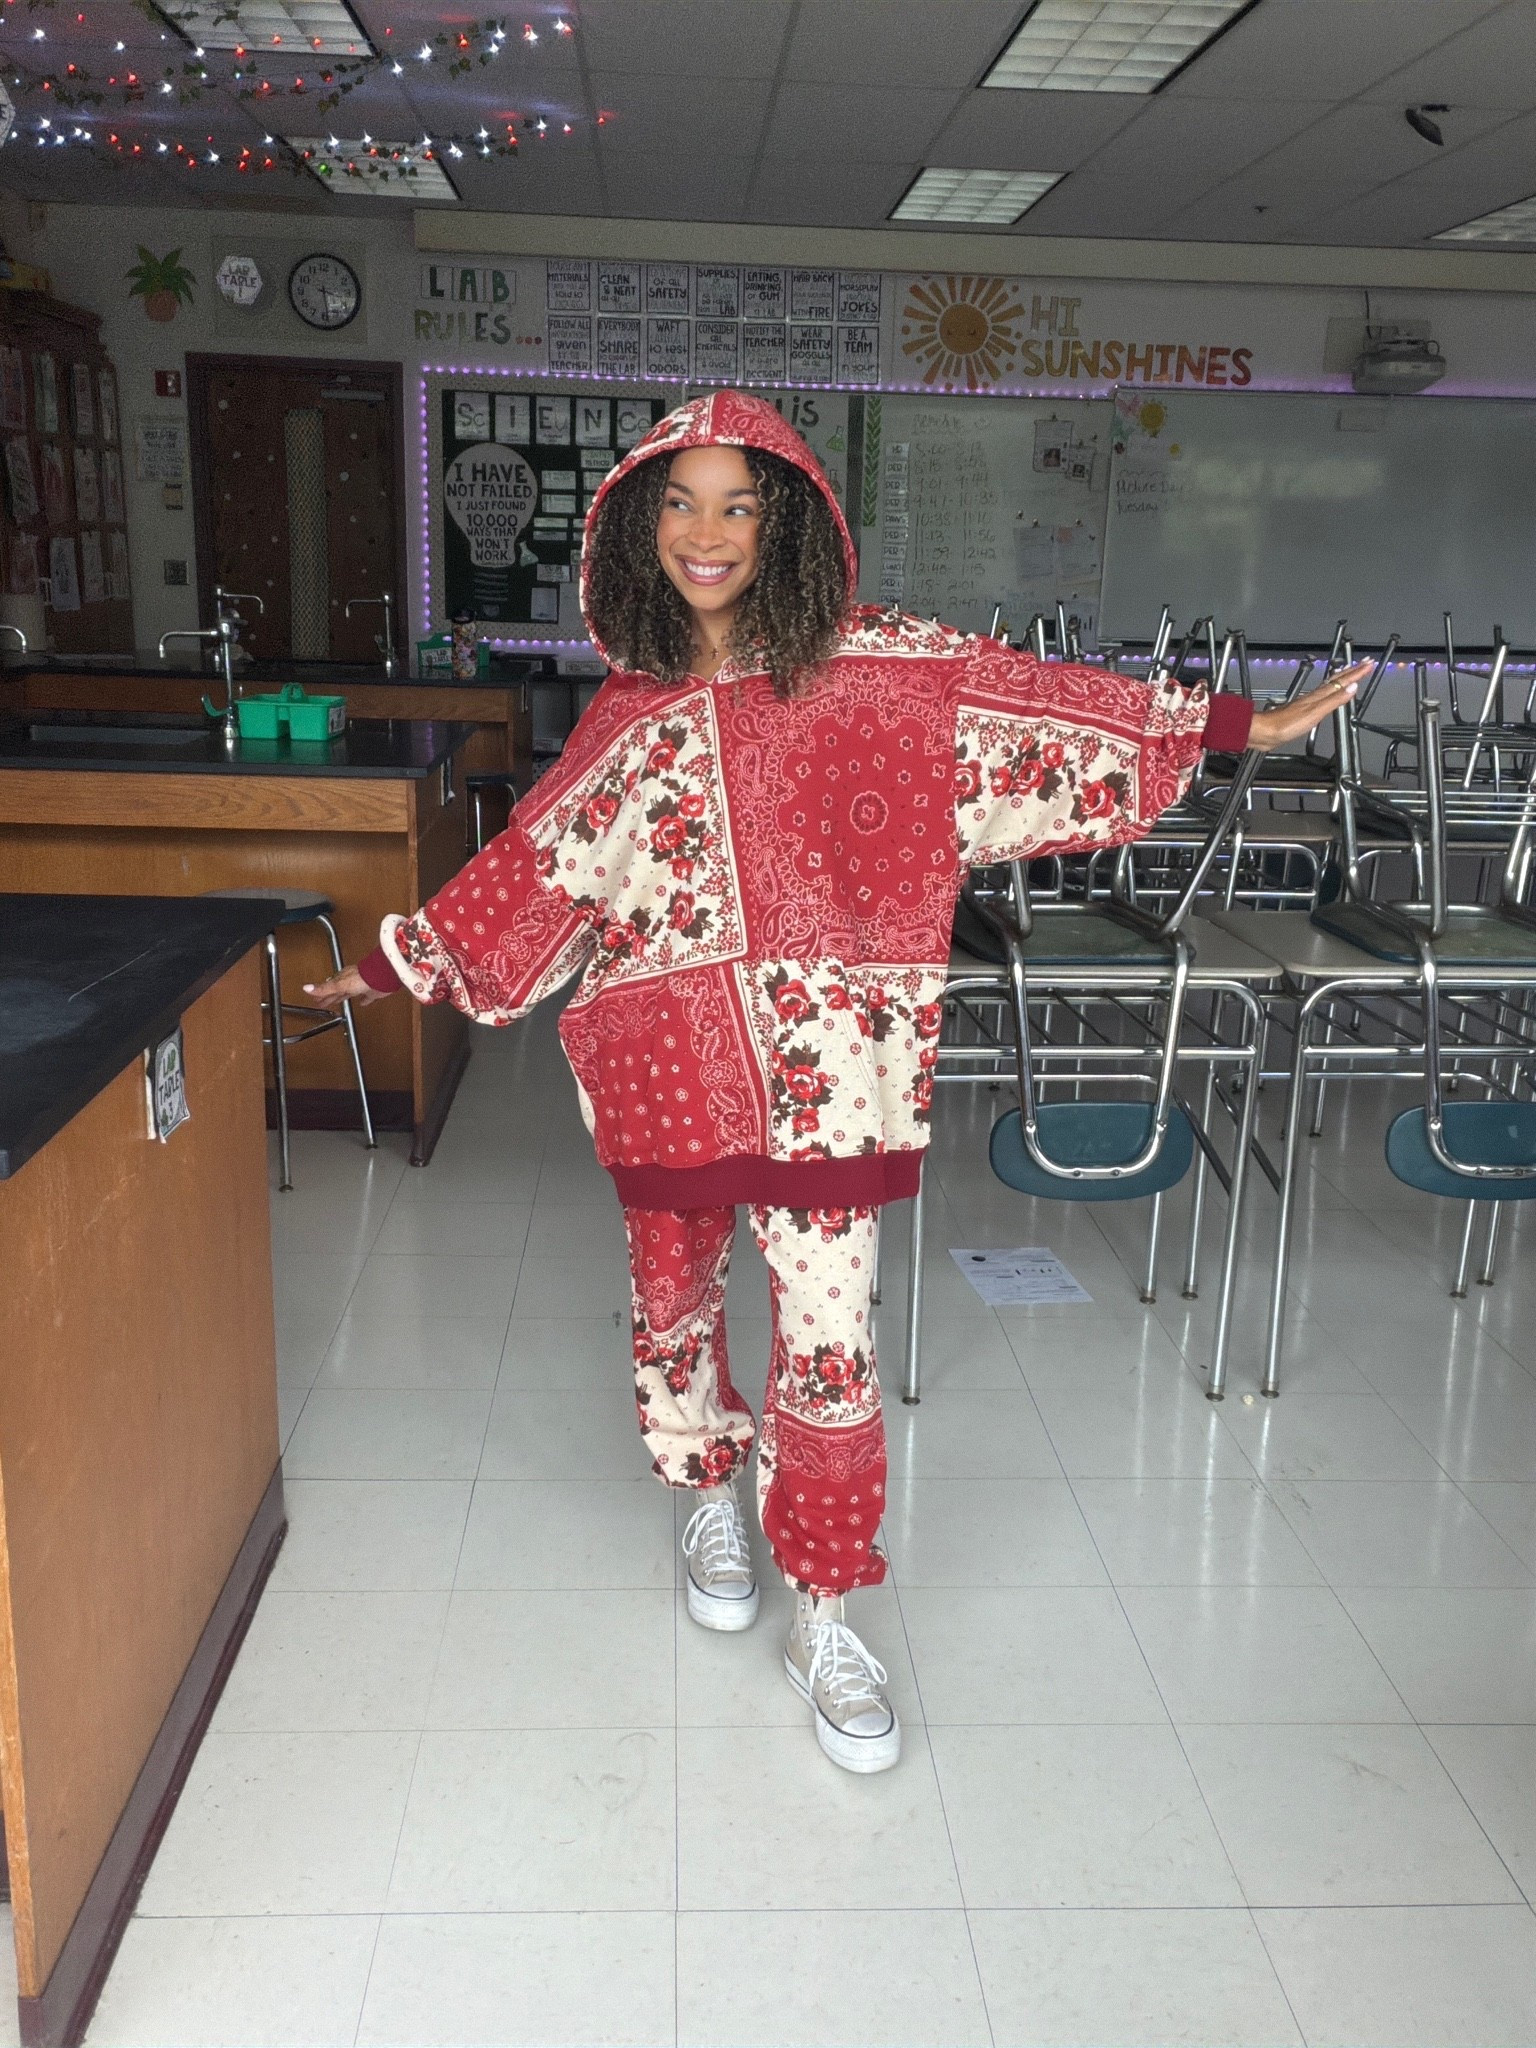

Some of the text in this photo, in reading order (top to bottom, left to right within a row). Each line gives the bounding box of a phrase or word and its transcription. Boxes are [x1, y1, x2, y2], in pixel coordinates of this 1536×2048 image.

[229, 265, 250, 275] LAB
[222, 274, 257, 288] TABLE
[548, 273, 590, 282] MATERIALS
[600, 275, 630, 284] CLEAN
[793, 274, 810, 282] HAIR
[813, 274, 834, 282] BACK
[429, 266, 510, 303] LAB
[614, 286, 636, 296] NEAT
[649, 287, 687, 299] SAFETY
[759, 292, 780, 301] GUM
[720, 305, 736, 315] LAB
[808, 306, 830, 318] FIRE
[841, 301, 878, 313] JOKES
[1031, 296, 1082, 336] HI
[549, 320, 591, 330] FOLLOW ALL
[599, 320, 640, 331] EVERYBODY
[656, 321, 681, 333] WAFT
[697, 323, 735, 335] CONSIDER
[745, 326, 783, 336] NOTIFY THE
[801, 327, 822, 338] WEAR
[848, 329, 867, 340] BE A
[556, 340, 587, 350] given
[600, 340, 638, 354] SHARE
[696, 343, 737, 351] CHEMICALS
[744, 337, 786, 347] TEACHER
[792, 338, 831, 350] SAFETY
[844, 341, 872, 353] TEAM
[649, 344, 688, 354] to test
[791, 350, 832, 359] GOGGLES
[551, 360, 588, 370] TEACHER
[599, 362, 636, 374] THE LAB
[1022, 339, 1254, 386] SUNSHINES
[649, 363, 687, 374] ODORS
[746, 369, 783, 379] ACCIDENT
[454, 463, 463, 482] I
[471, 463, 528, 483] HAVE
[447, 483, 476, 497] NOT
[457, 501, 526, 511] I JUST FOUND
[466, 514, 518, 528] 10,000
[466, 527, 517, 537] WAYS THAT
[475, 538, 509, 549] WON'T
[162, 1049, 177, 1078] LAB
[159, 1070, 180, 1106] TABLE
